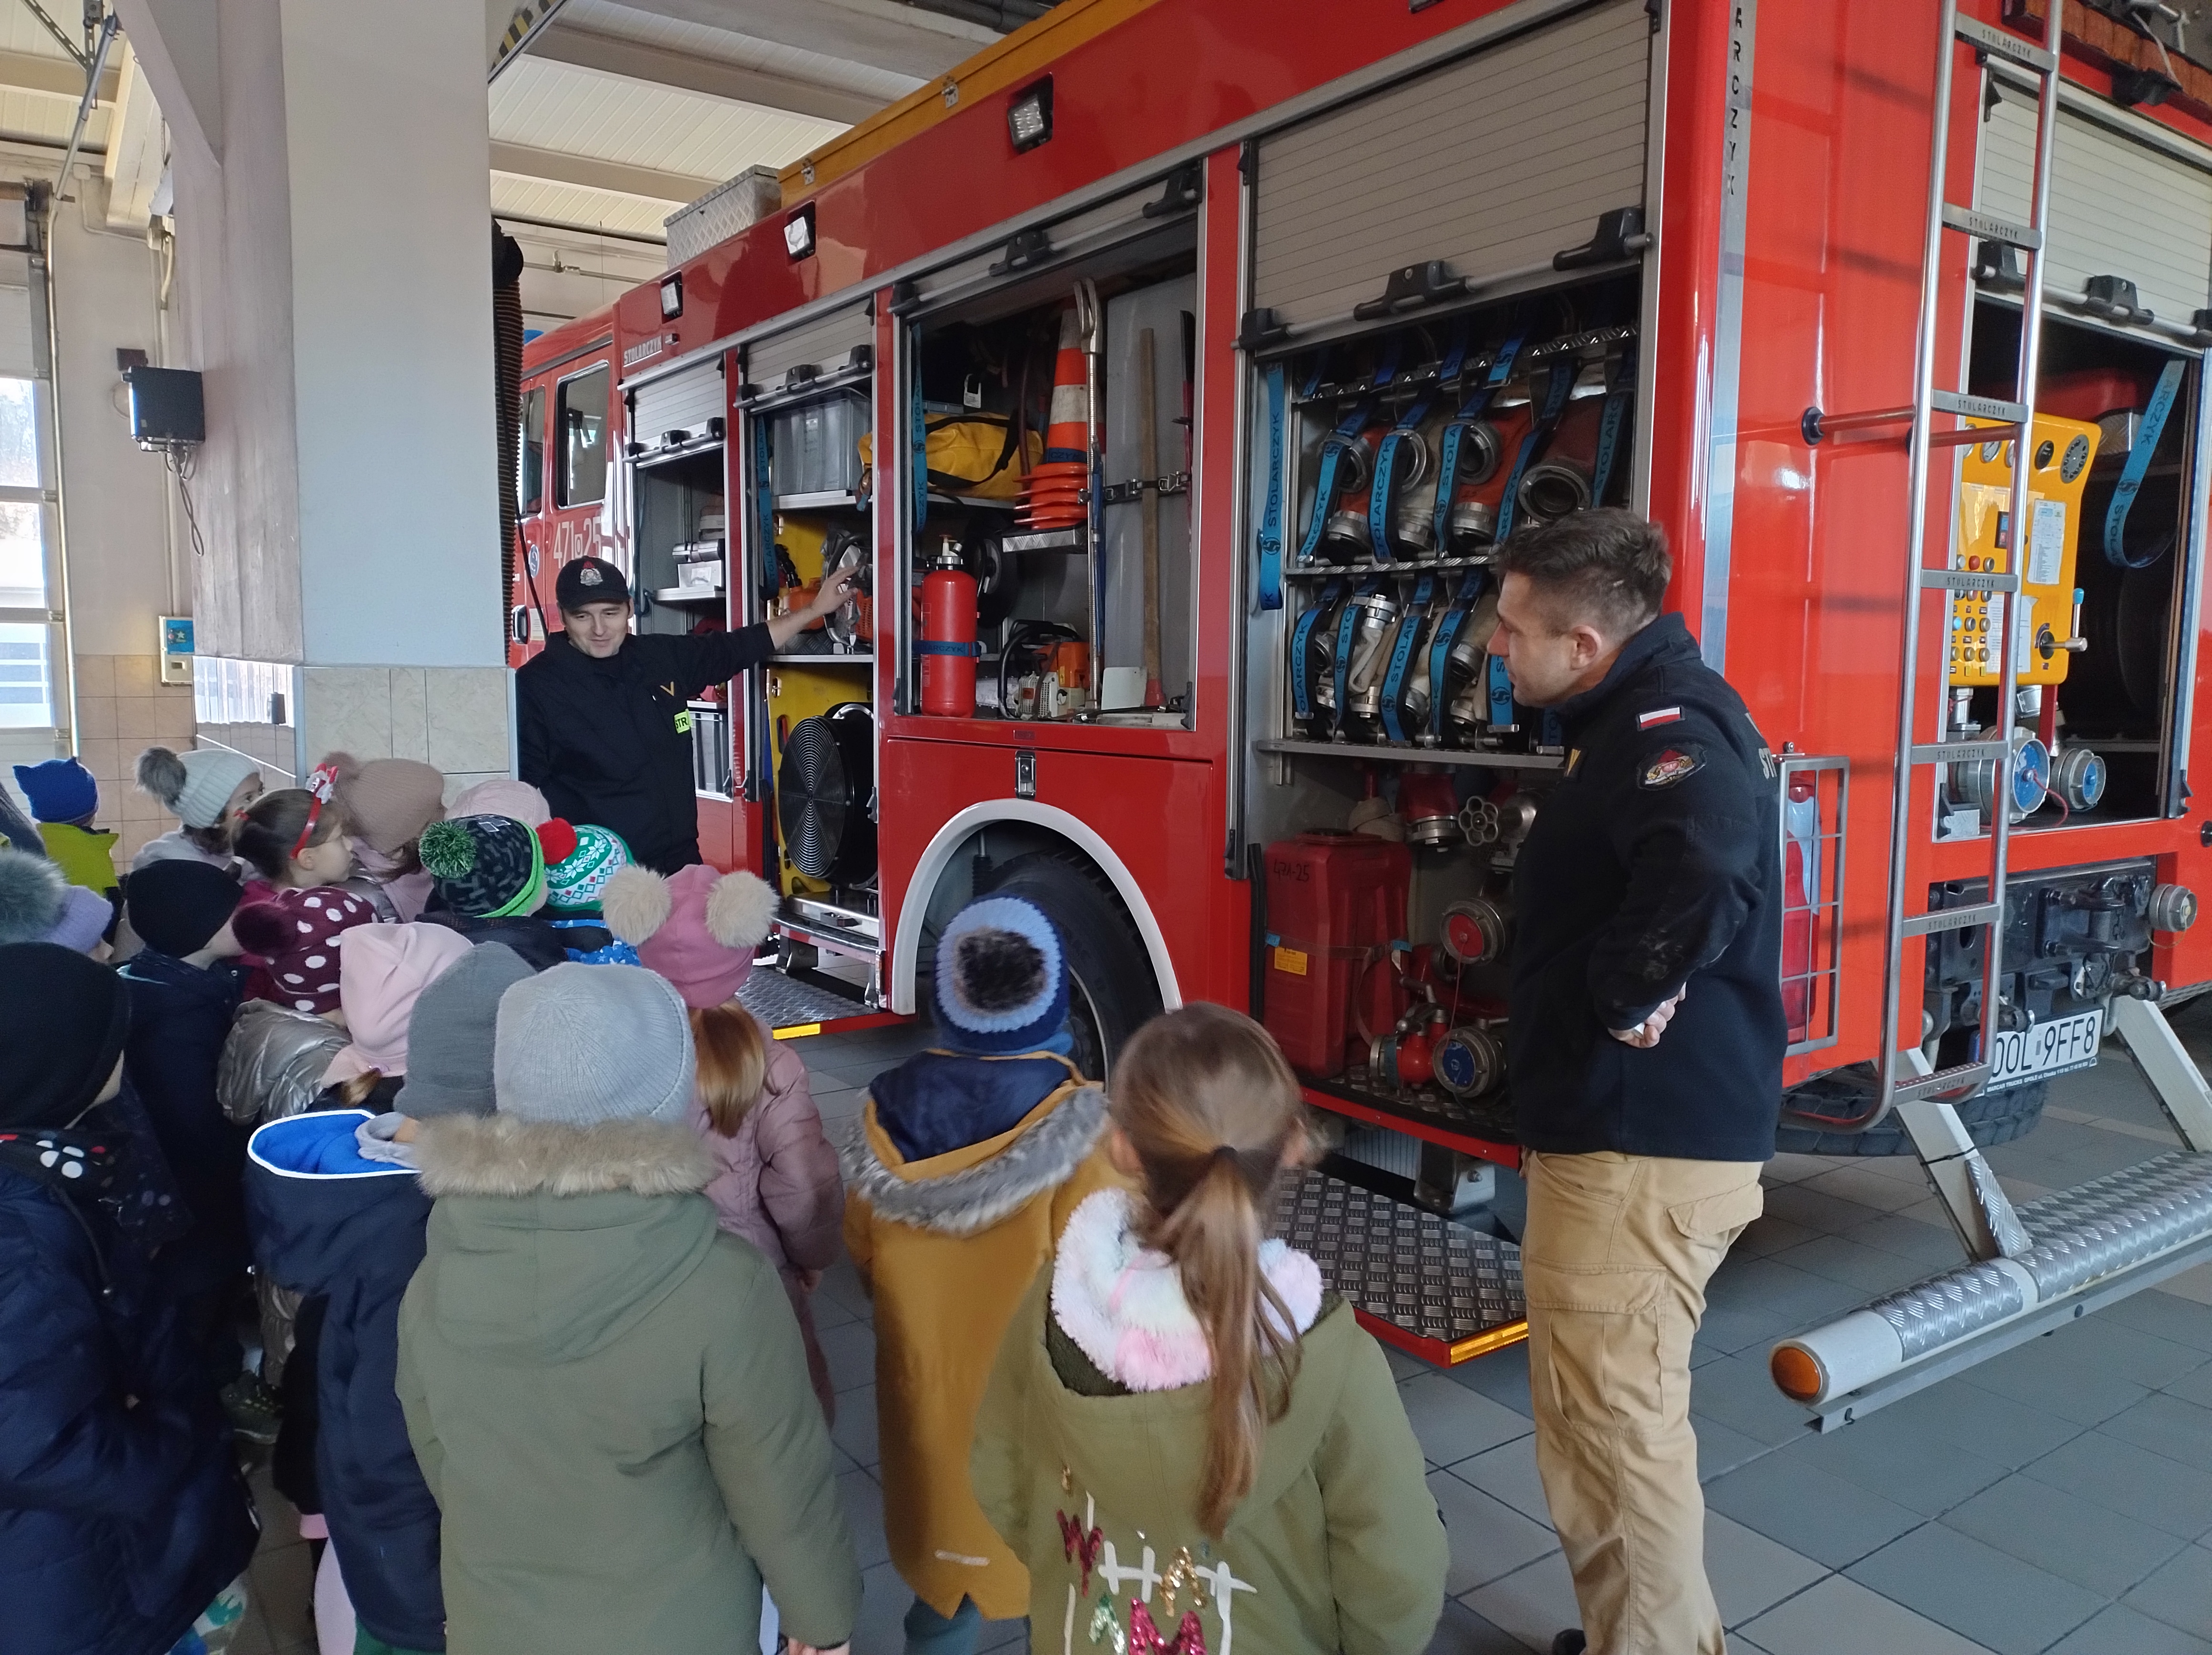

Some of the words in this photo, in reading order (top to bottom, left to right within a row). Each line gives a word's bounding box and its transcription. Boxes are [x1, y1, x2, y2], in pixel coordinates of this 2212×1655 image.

[1982, 29, 2031, 58] STOLARCZYK
[1969, 217, 2018, 240] STOLARCZYK
[624, 335, 662, 365] STOLARCZYK
[1958, 399, 2006, 416] STOLARCZYK
[1268, 412, 1280, 527] STOLARCZYK
[553, 521, 574, 569] 471
[763, 513, 776, 587] STOLARCZYK
[1947, 577, 1995, 588] STOLARCZYK
[1937, 749, 1985, 760] STOLARCZYK
[1928, 914, 1976, 930] STOLARCZYK
[2042, 1016, 2096, 1066] 9FF8
[1917, 1076, 1965, 1097] STOLARCZYK
